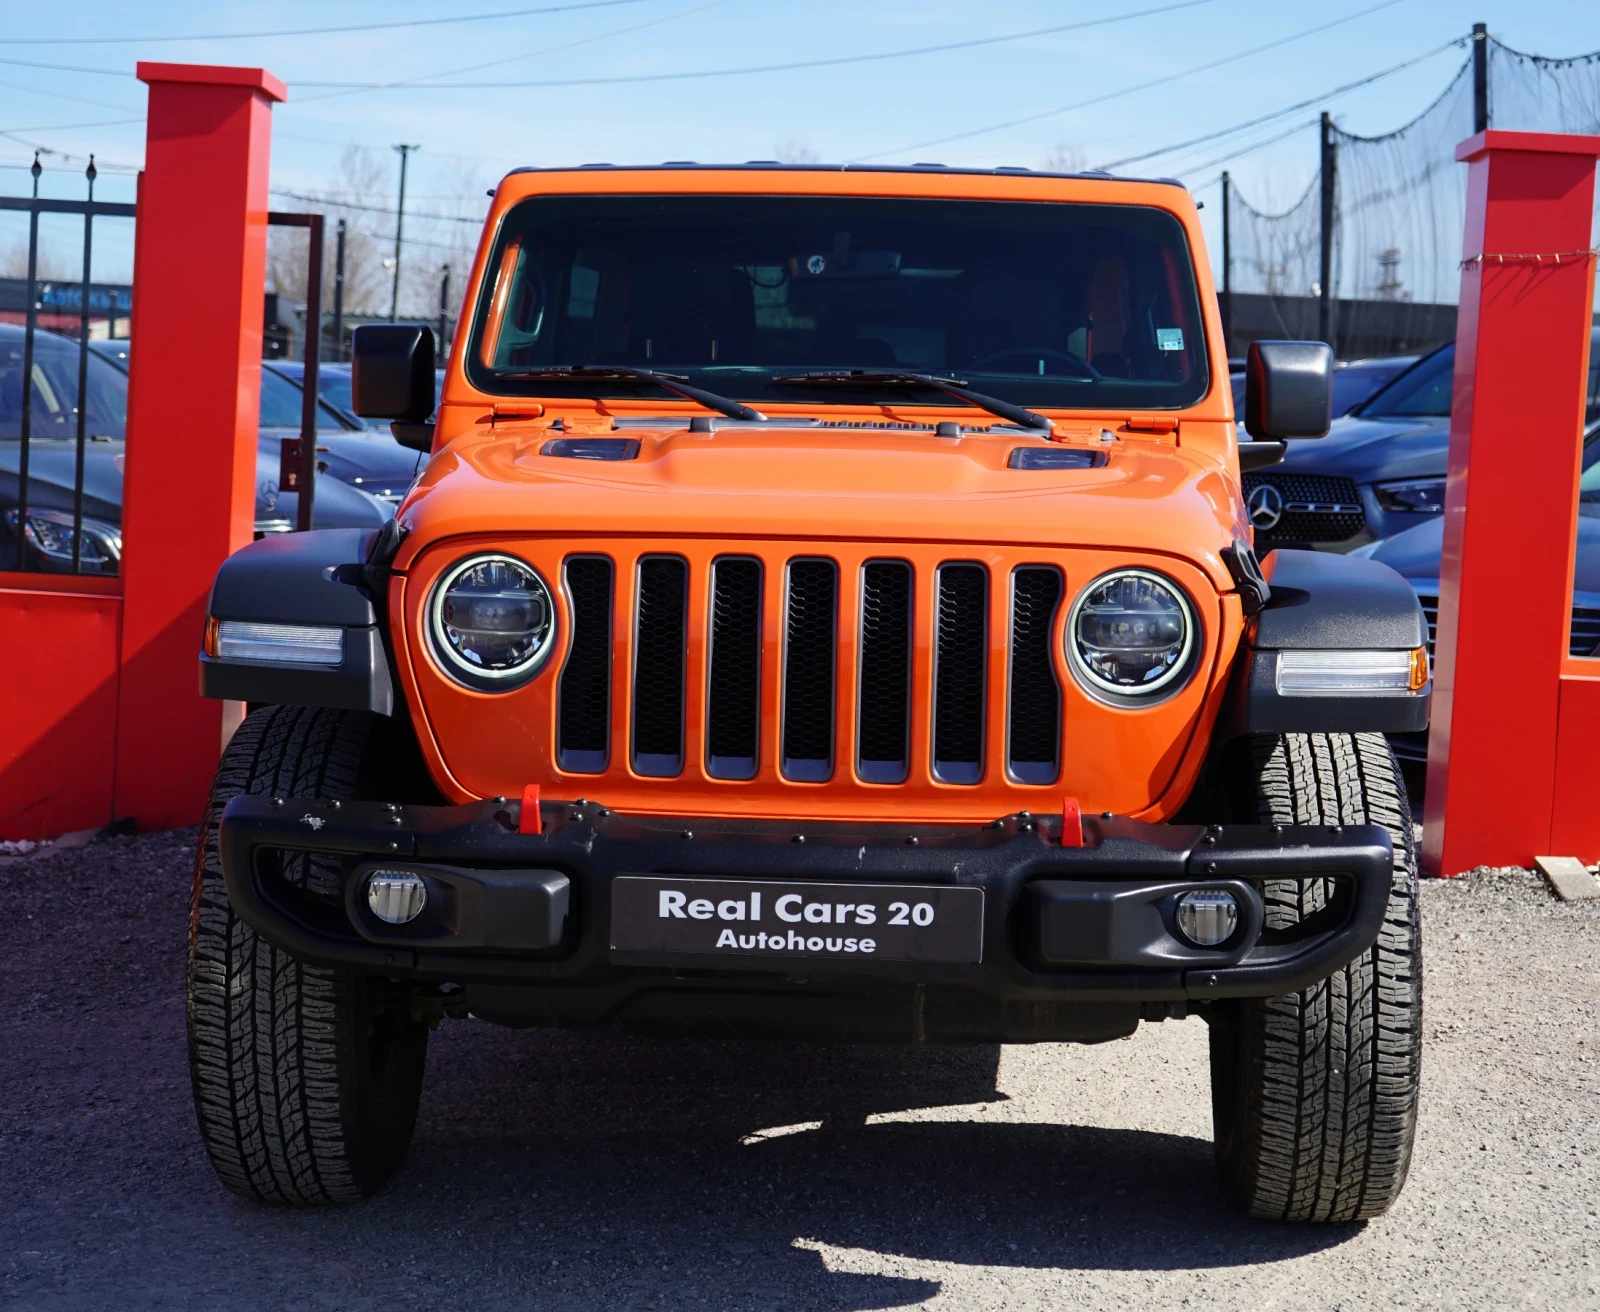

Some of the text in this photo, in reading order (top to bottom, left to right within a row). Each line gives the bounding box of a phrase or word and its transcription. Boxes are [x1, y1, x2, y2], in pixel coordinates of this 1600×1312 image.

[659, 890, 935, 926] Real Cars 20
[715, 929, 876, 953] Autohouse
